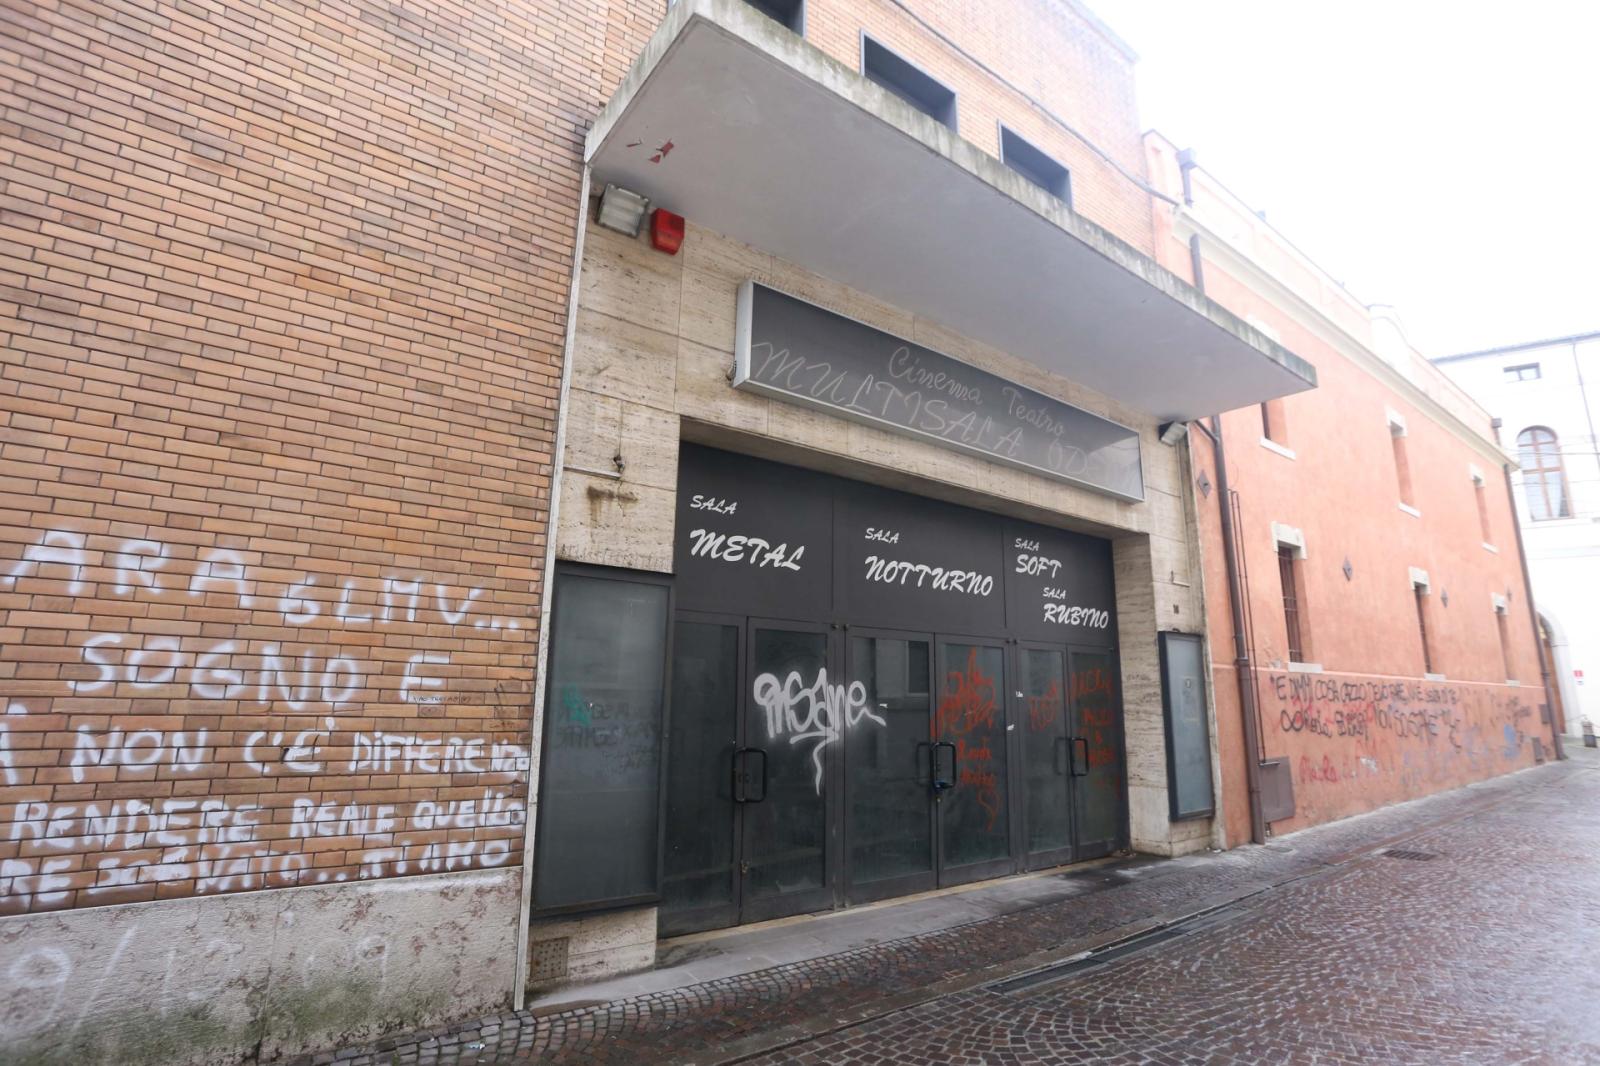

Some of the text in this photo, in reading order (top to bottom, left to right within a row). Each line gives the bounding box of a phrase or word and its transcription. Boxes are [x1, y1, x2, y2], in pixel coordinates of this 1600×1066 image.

[752, 342, 1024, 457] MULTISALA
[889, 346, 1064, 437] Cinema Teatro
[690, 495, 737, 514] SALA
[689, 528, 805, 571] METAL
[865, 527, 900, 544] SALA
[1014, 538, 1039, 551] SALA
[864, 555, 994, 596] NOTTURNO
[1015, 554, 1062, 578] SOFT
[1042, 587, 1066, 600] SALA
[1043, 603, 1109, 629] RUBINO
[66, 633, 450, 712] SOGNO E
[70, 723, 209, 784] NON
[10, 799, 264, 849] RENDERE
[288, 797, 397, 844] REALE
